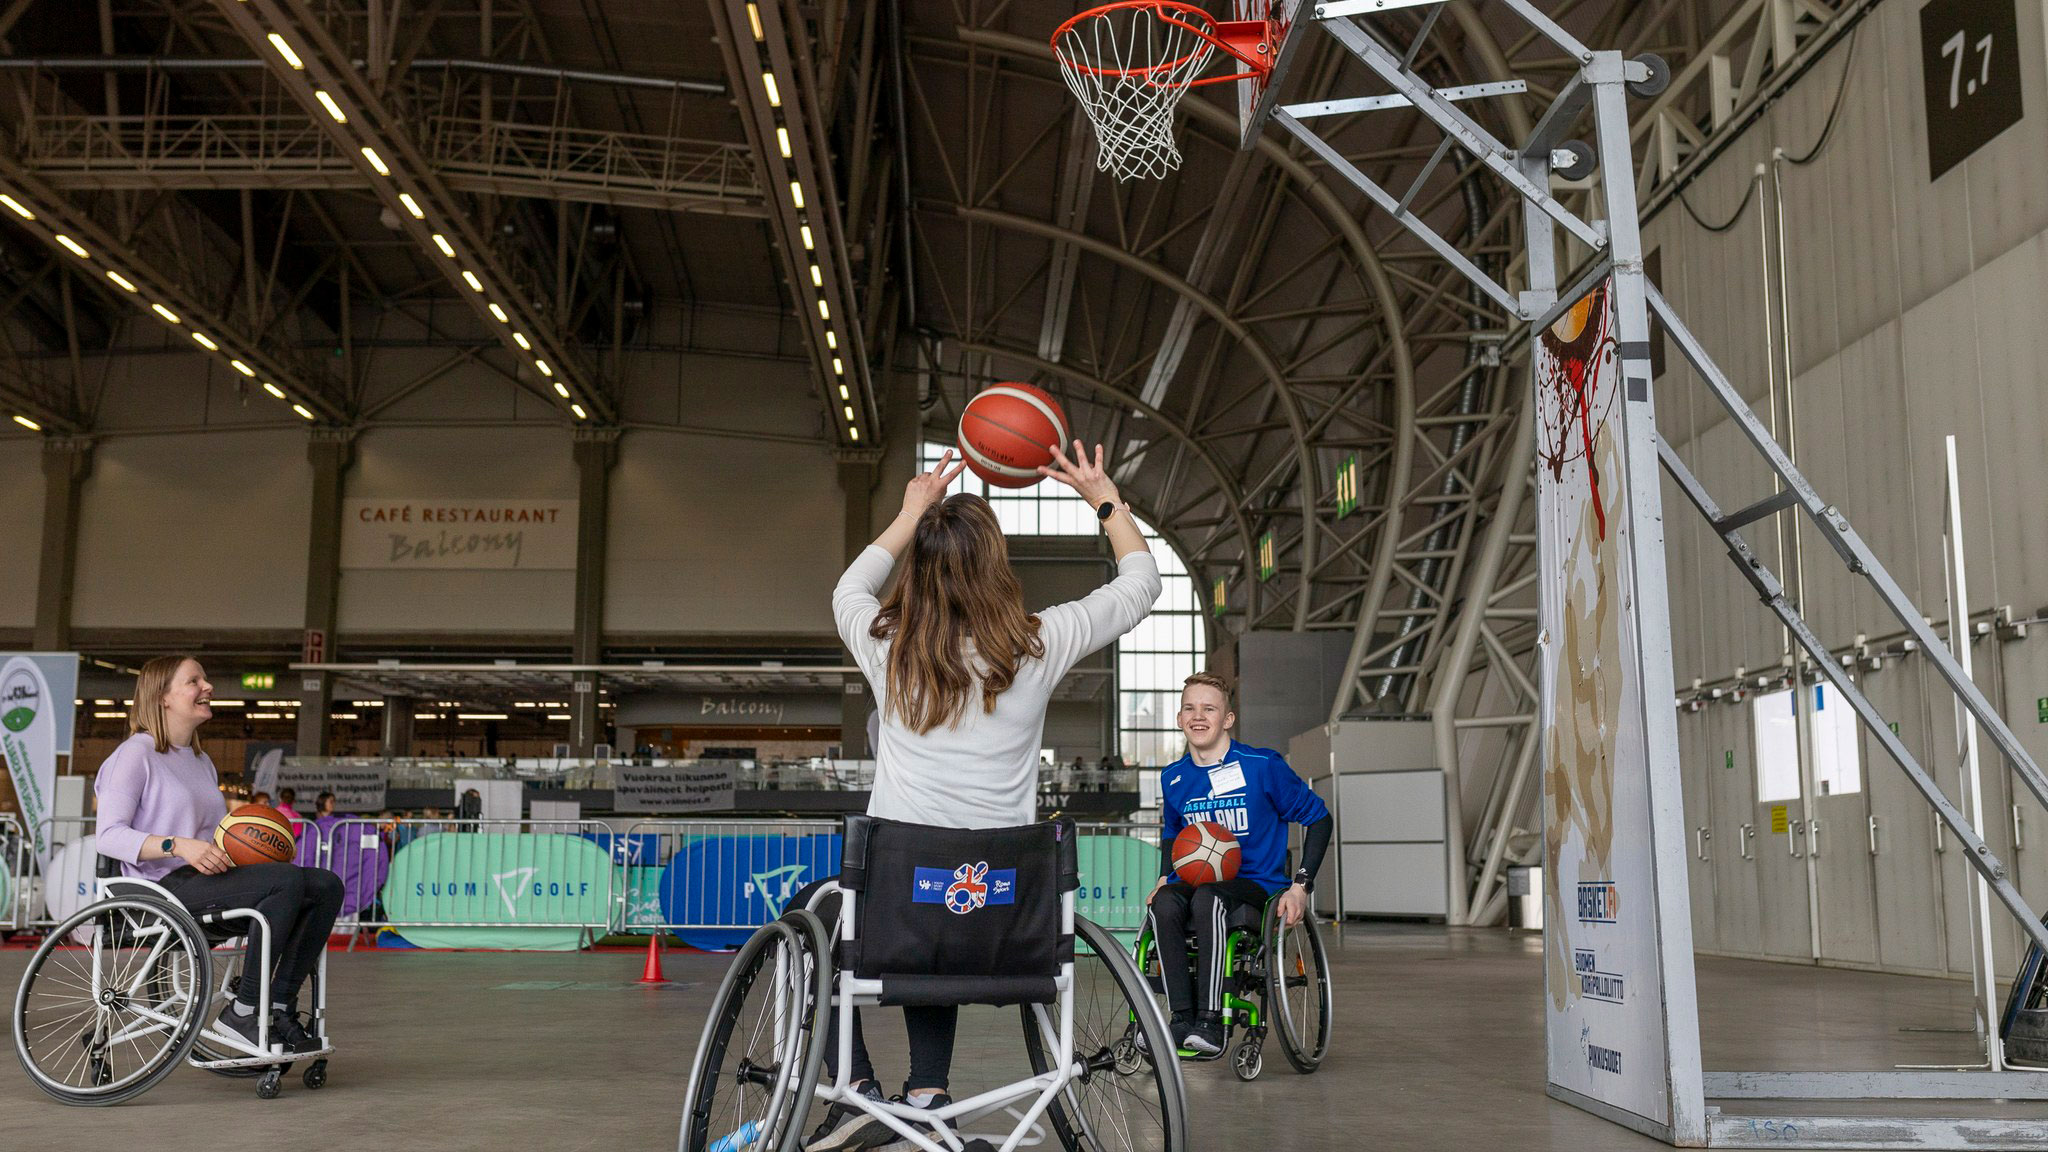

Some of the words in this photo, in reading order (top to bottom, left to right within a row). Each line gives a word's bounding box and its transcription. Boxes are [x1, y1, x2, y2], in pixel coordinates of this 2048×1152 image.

[359, 505, 412, 523] CAFÉ
[422, 508, 560, 523] RESTAURANT
[388, 529, 524, 567] Balcony
[700, 697, 785, 725] Balcony
[623, 773, 672, 782] Vuokraa
[675, 771, 728, 781] liikunnan
[616, 783, 682, 795] apuvälineet
[685, 781, 733, 794] helposti!
[243, 826, 290, 856] molten
[416, 882, 489, 897] SUOMI
[533, 882, 589, 897] GOLF
[1078, 886, 1128, 899] GOLF
[1577, 886, 1617, 919] BASKET.FI
[1575, 952, 1596, 973] SUOMEN
[1581, 974, 1624, 1000] KORIPALLOLIITTO
